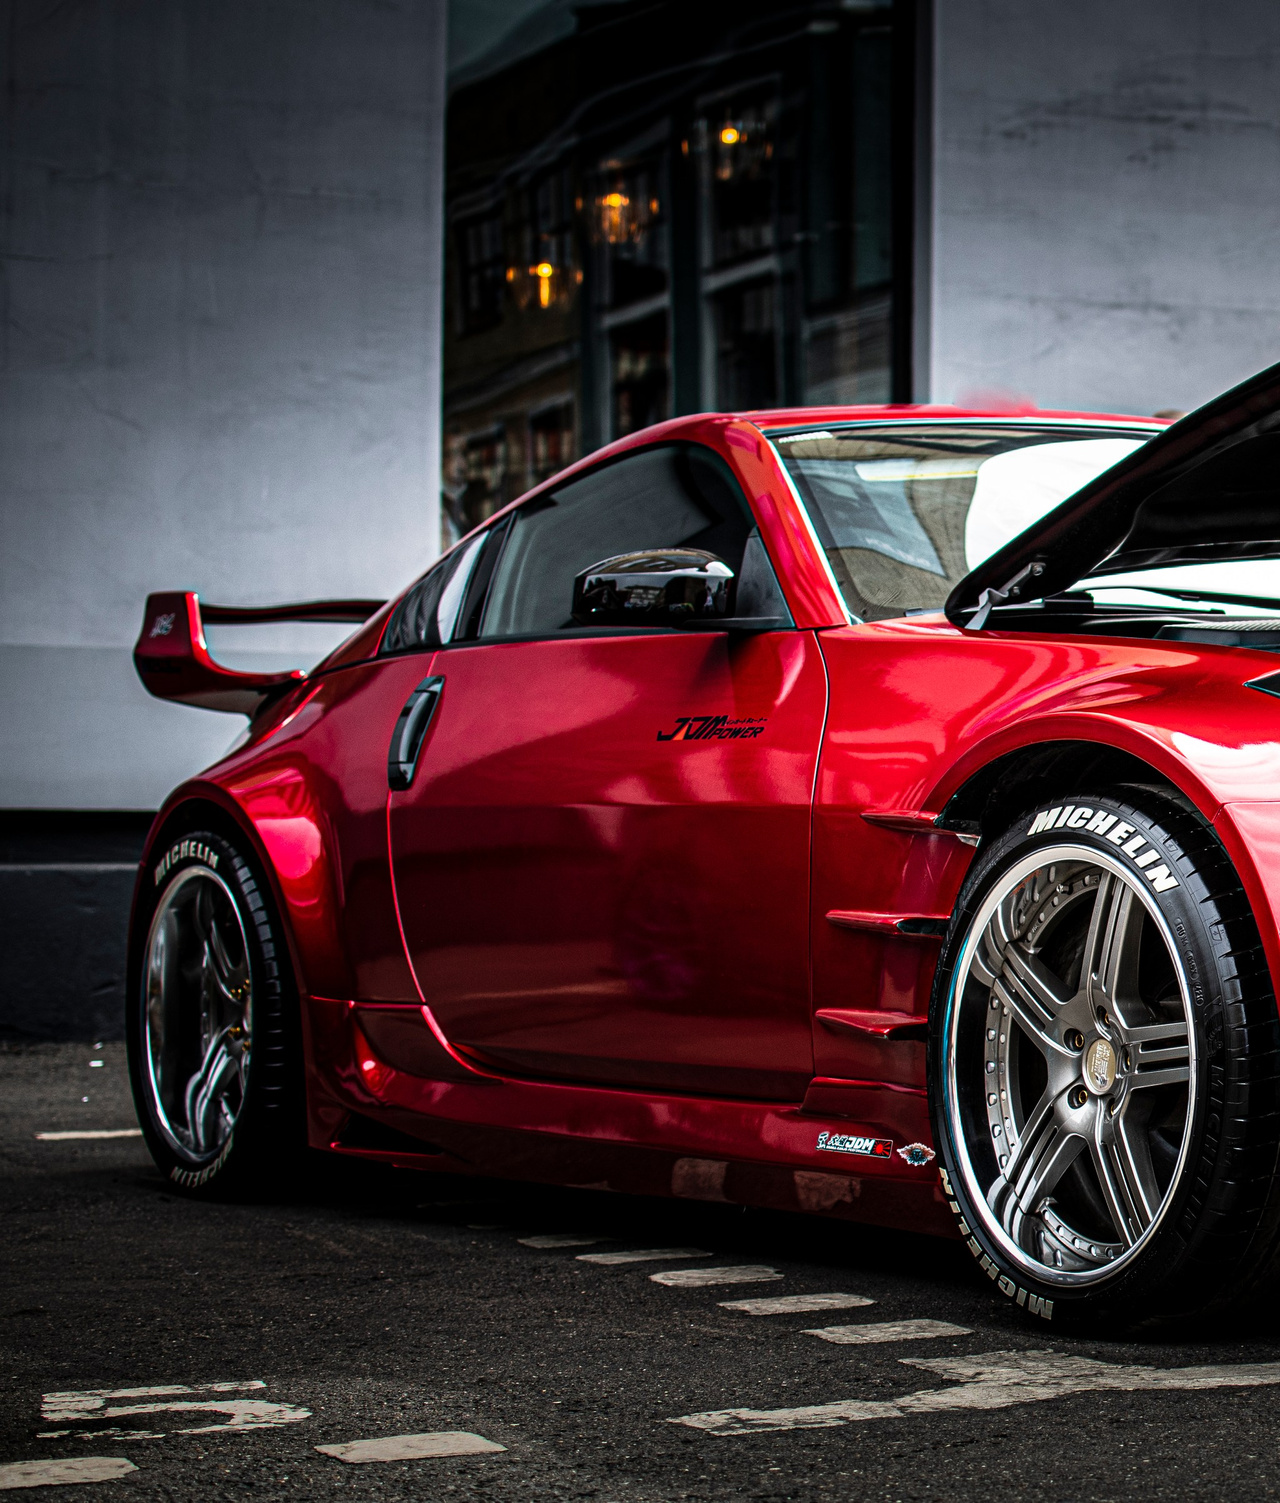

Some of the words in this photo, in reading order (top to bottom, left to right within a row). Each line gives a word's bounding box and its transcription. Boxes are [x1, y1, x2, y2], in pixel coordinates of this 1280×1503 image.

[708, 727, 764, 740] POWER
[154, 839, 219, 887] MICHELIN
[1027, 805, 1180, 893] MICHELIN
[845, 1137, 875, 1151] JDM
[939, 1167, 1054, 1320] MICHELIN
